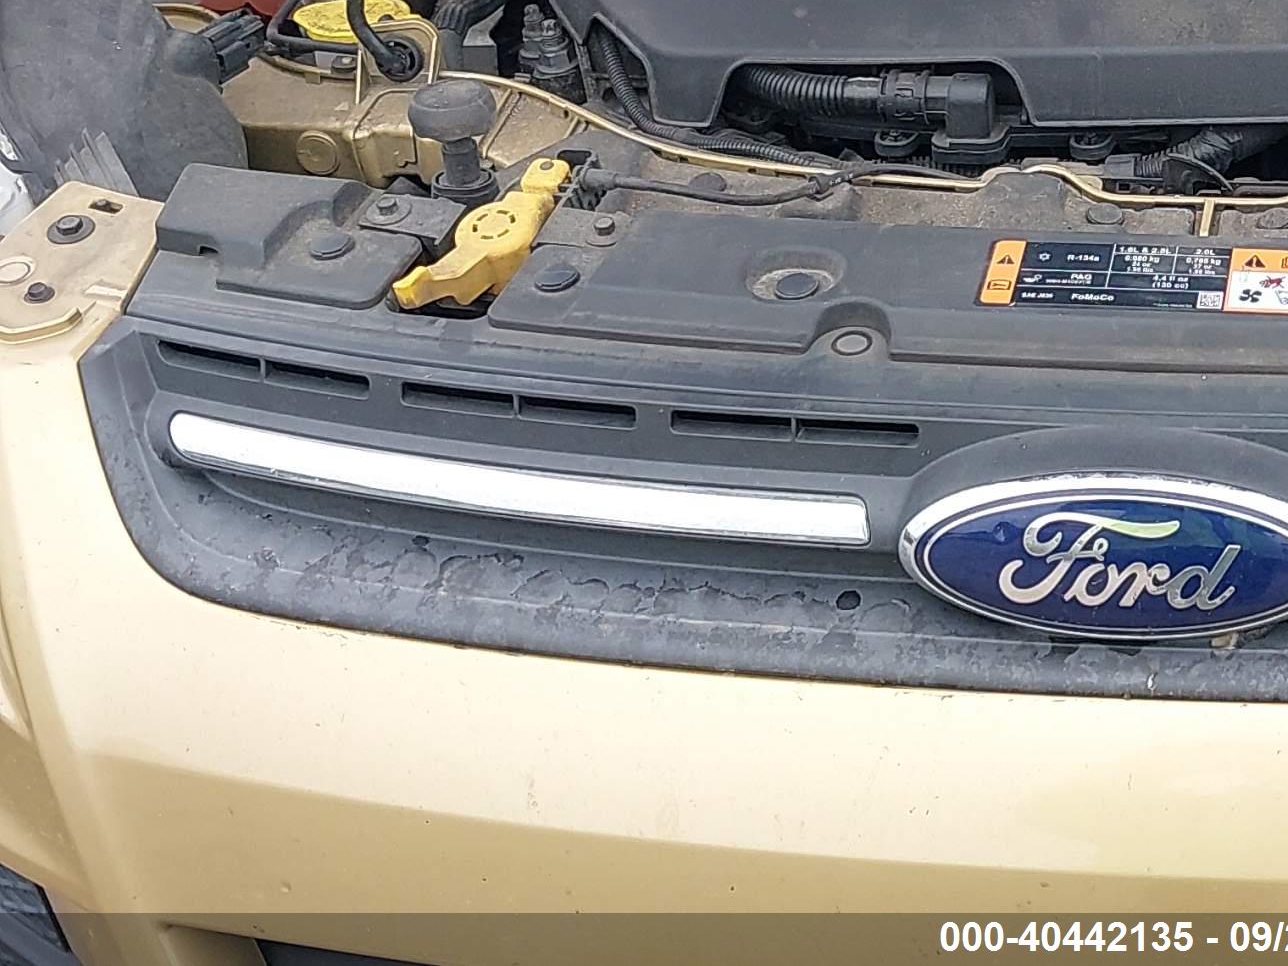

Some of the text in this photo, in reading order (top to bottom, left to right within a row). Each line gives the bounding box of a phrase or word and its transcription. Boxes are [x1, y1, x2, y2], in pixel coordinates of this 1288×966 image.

[1066, 254, 1100, 262] R-134a
[1071, 293, 1115, 301] FoMoCo
[998, 511, 1242, 611] Ford
